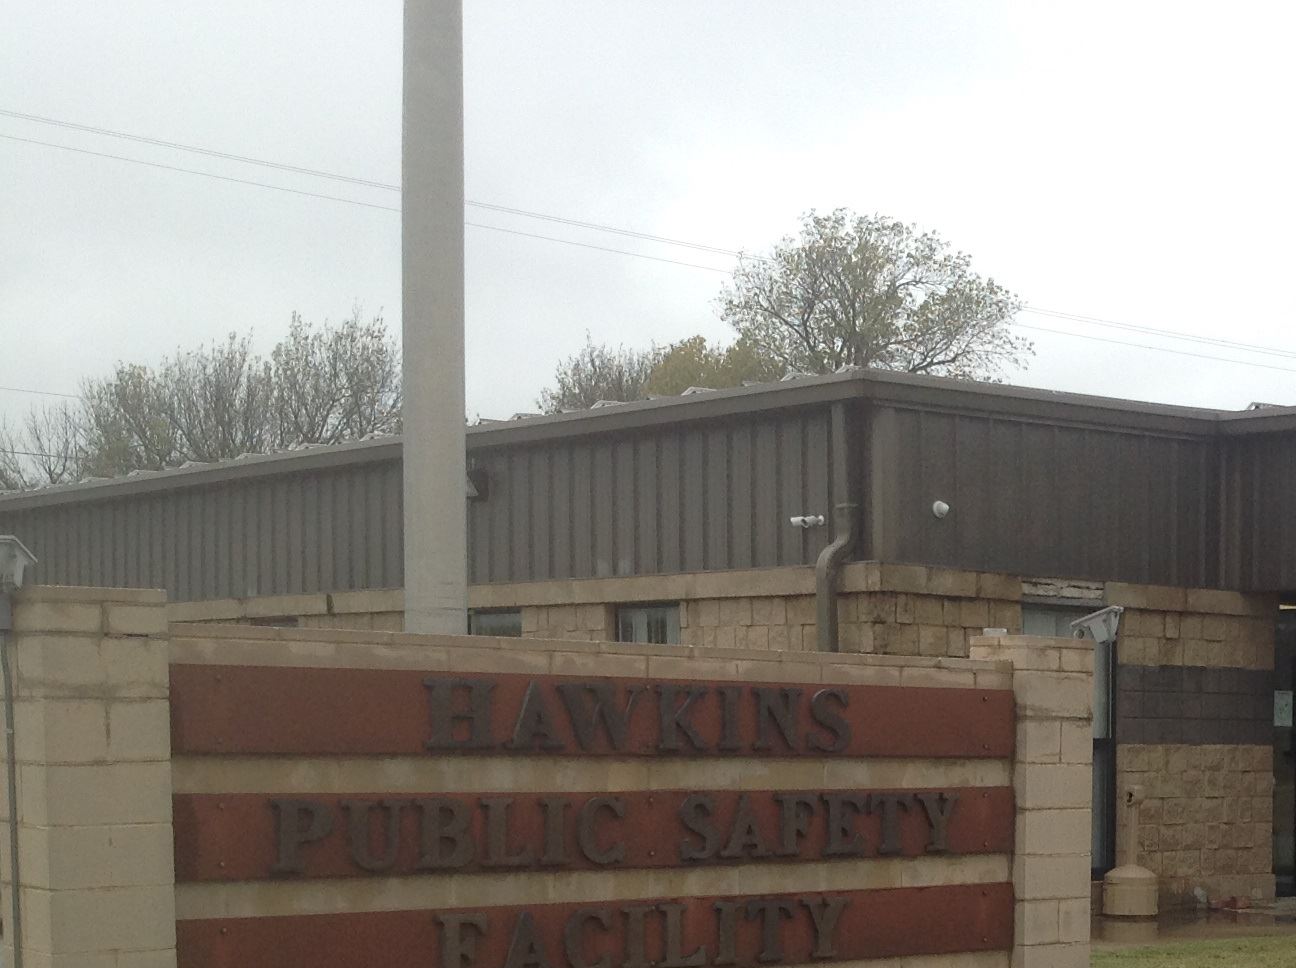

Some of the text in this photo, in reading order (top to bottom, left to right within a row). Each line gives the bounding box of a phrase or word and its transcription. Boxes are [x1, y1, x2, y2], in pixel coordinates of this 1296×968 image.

[423, 678, 852, 752] HAWKINS
[269, 793, 960, 877] PUBLIC SAFETY
